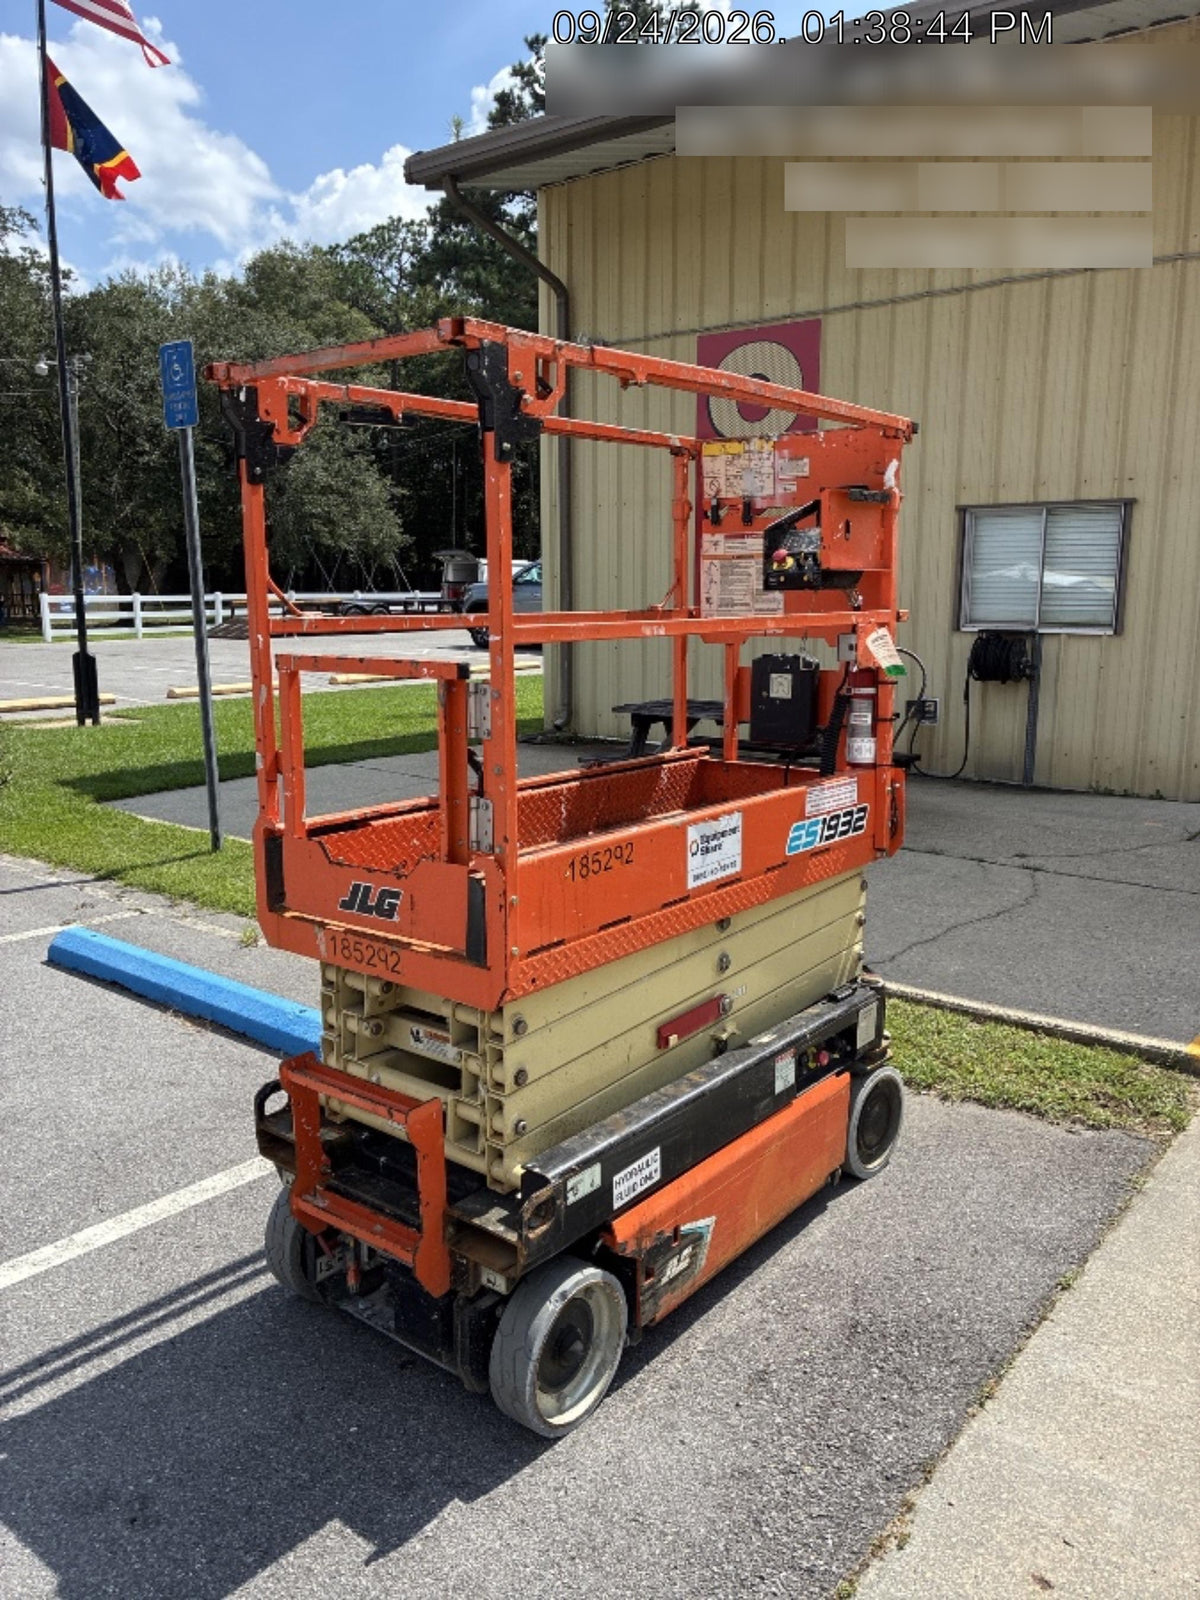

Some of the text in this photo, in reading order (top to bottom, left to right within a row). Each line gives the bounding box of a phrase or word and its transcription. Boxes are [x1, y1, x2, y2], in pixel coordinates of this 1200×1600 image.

[786, 804, 869, 855] ES1932
[568, 841, 635, 883] 185292
[338, 881, 403, 922] JLG
[329, 935, 402, 975] 185292
[614, 1152, 659, 1190] HYDRAULIC
[614, 1180, 639, 1203] FLUID
[639, 1167, 659, 1187] ONLY
